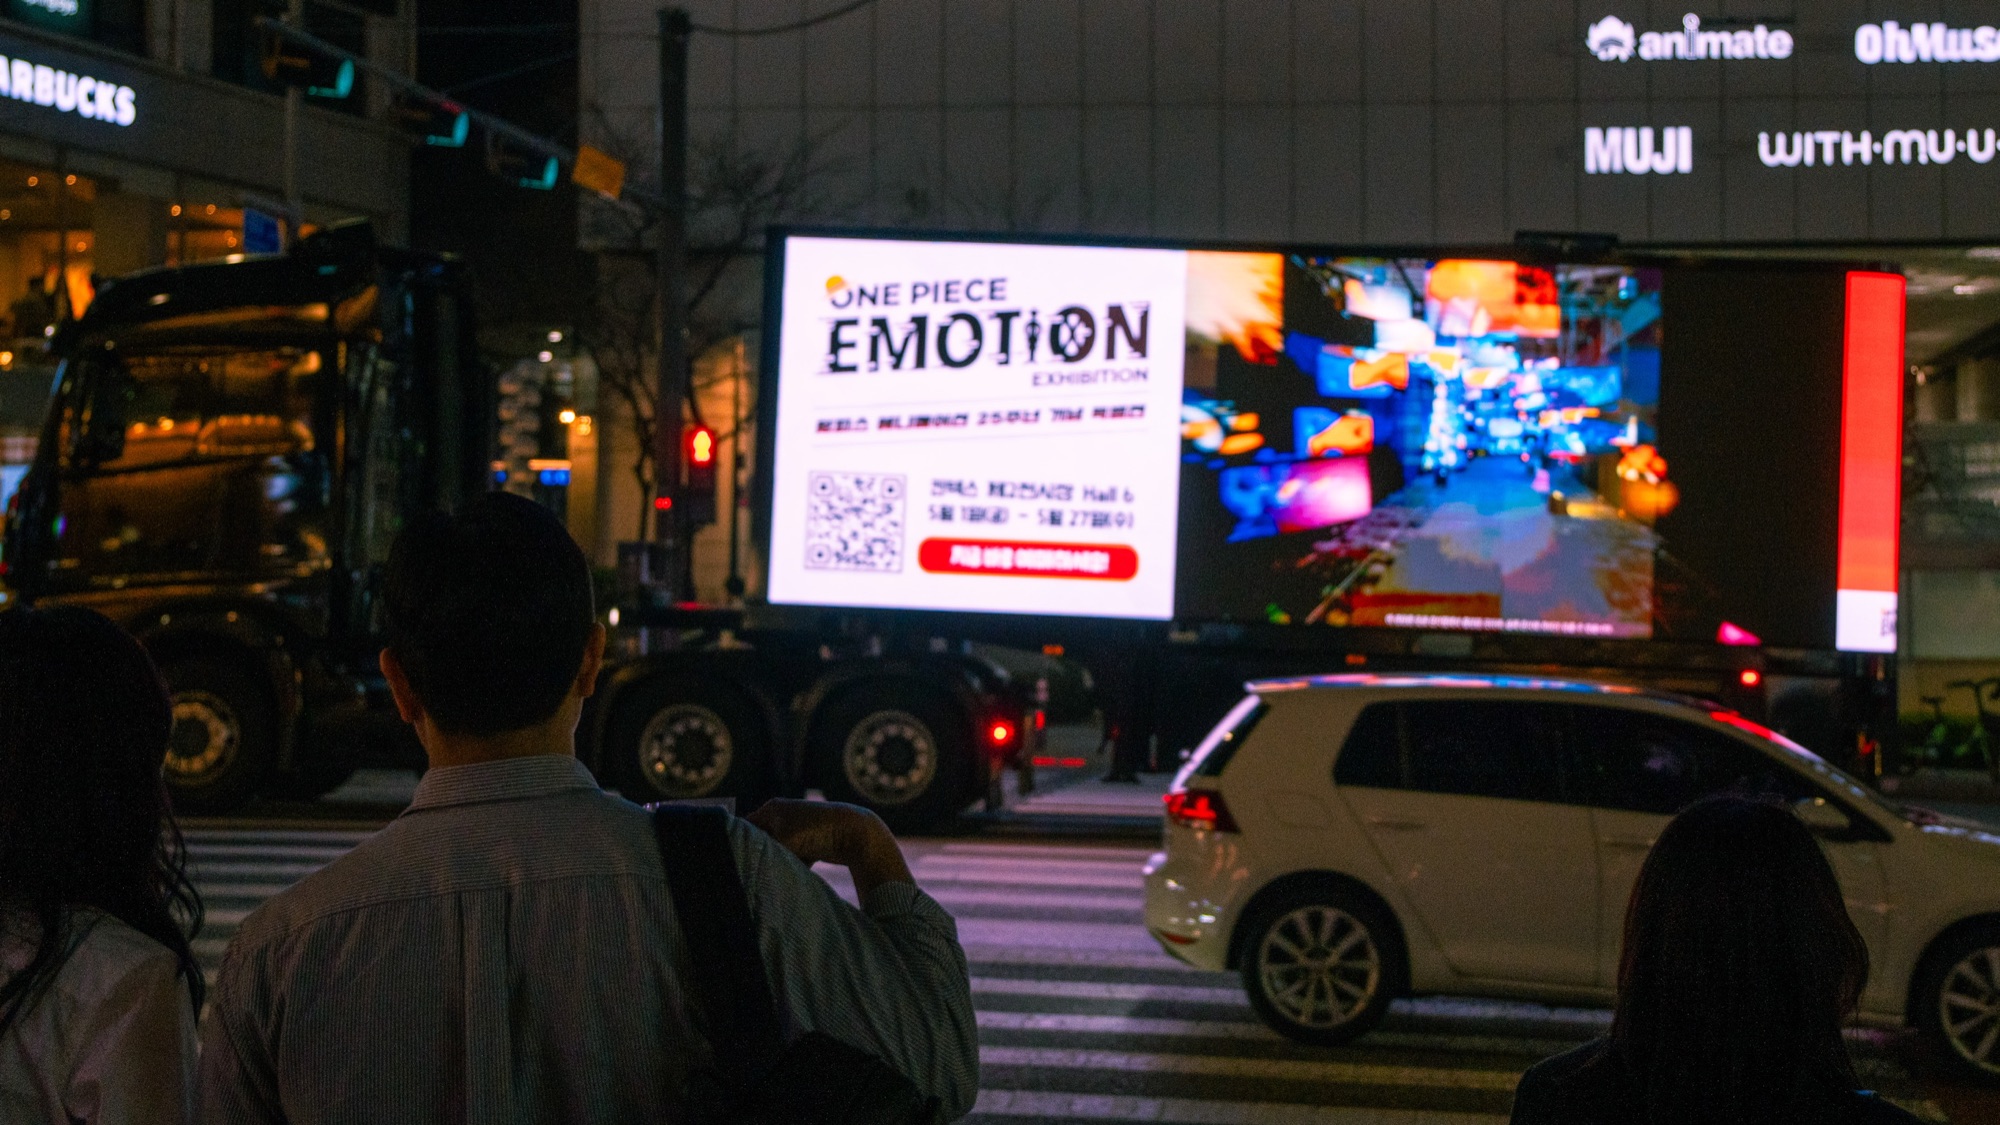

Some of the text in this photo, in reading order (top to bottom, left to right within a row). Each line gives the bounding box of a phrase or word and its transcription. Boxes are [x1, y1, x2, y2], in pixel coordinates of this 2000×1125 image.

[1638, 14, 1794, 60] animate
[1854, 20, 2000, 64] OhMus
[1584, 126, 1693, 174] MUJI
[829, 277, 1008, 309] ONE PIECE
[1031, 368, 1150, 387] EXHIBITION
[1082, 485, 1117, 503] Hall
